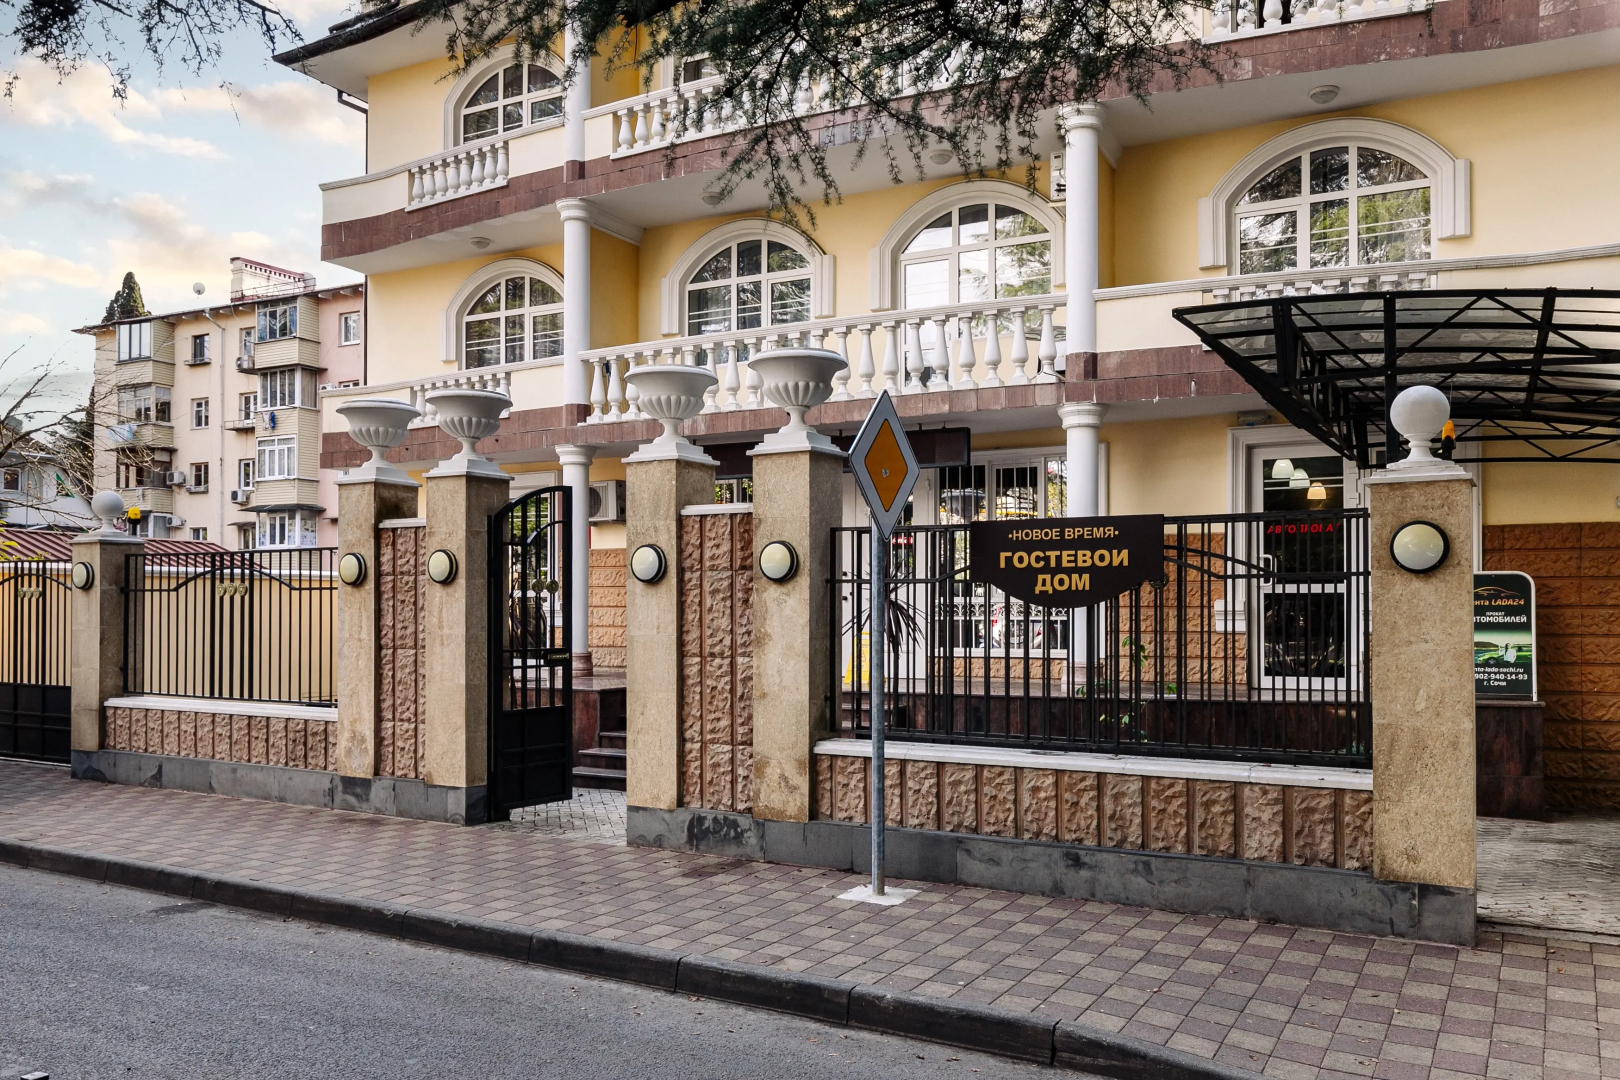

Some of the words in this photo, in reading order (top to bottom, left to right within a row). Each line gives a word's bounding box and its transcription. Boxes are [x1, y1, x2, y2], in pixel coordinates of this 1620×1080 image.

[1267, 523, 1341, 534] АВТОПОАТ
[1034, 573, 1090, 595] ДОМ
[1491, 598, 1525, 606] LADA24
[1473, 614, 1527, 623] ТОМОБИЛЕЙ
